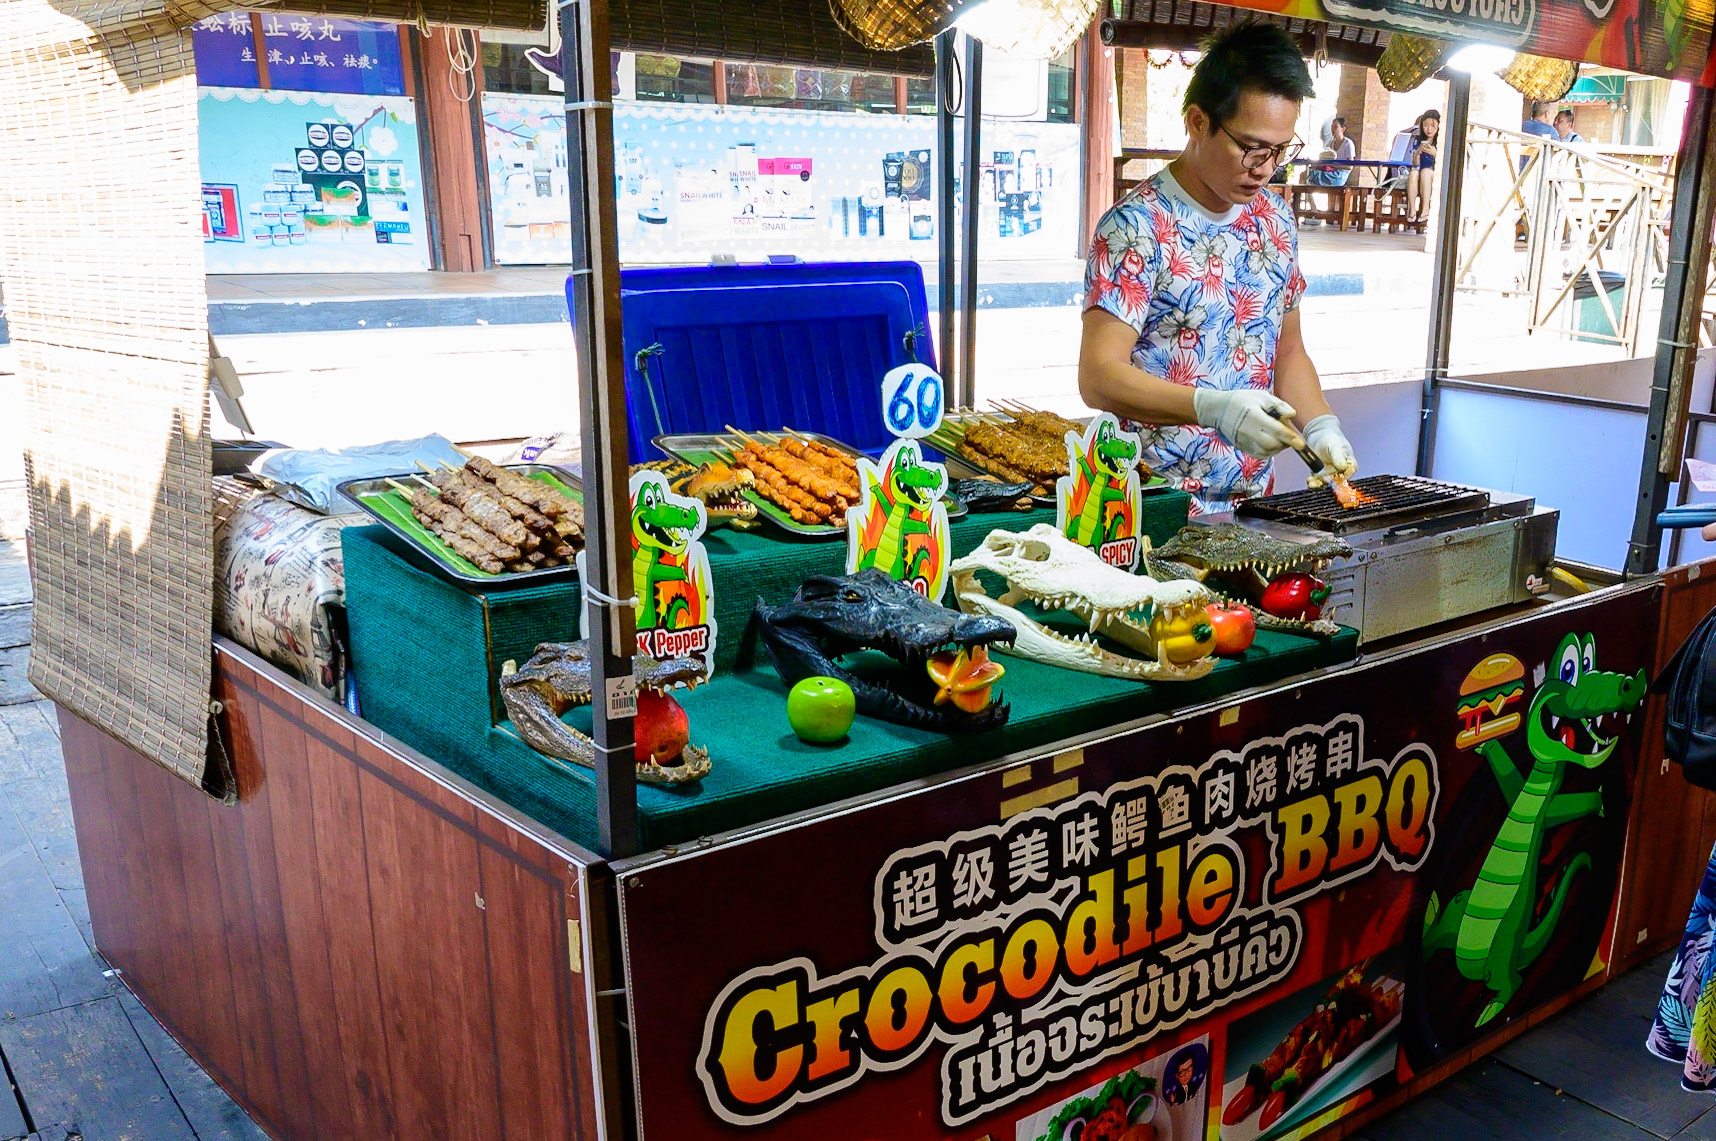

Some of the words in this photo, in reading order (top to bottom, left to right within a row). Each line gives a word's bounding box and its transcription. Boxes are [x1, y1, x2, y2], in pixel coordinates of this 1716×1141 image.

[887, 372, 941, 431] 60
[1101, 541, 1134, 566] SPICY
[656, 629, 705, 656] Pepper
[892, 730, 1353, 931] 超级美味鳄鱼肉烧烤串
[717, 844, 1234, 1104] Crocodile
[1274, 758, 1431, 895] BBQ
[958, 920, 1291, 1106] เนื้อจระเข้บาบีคิว
